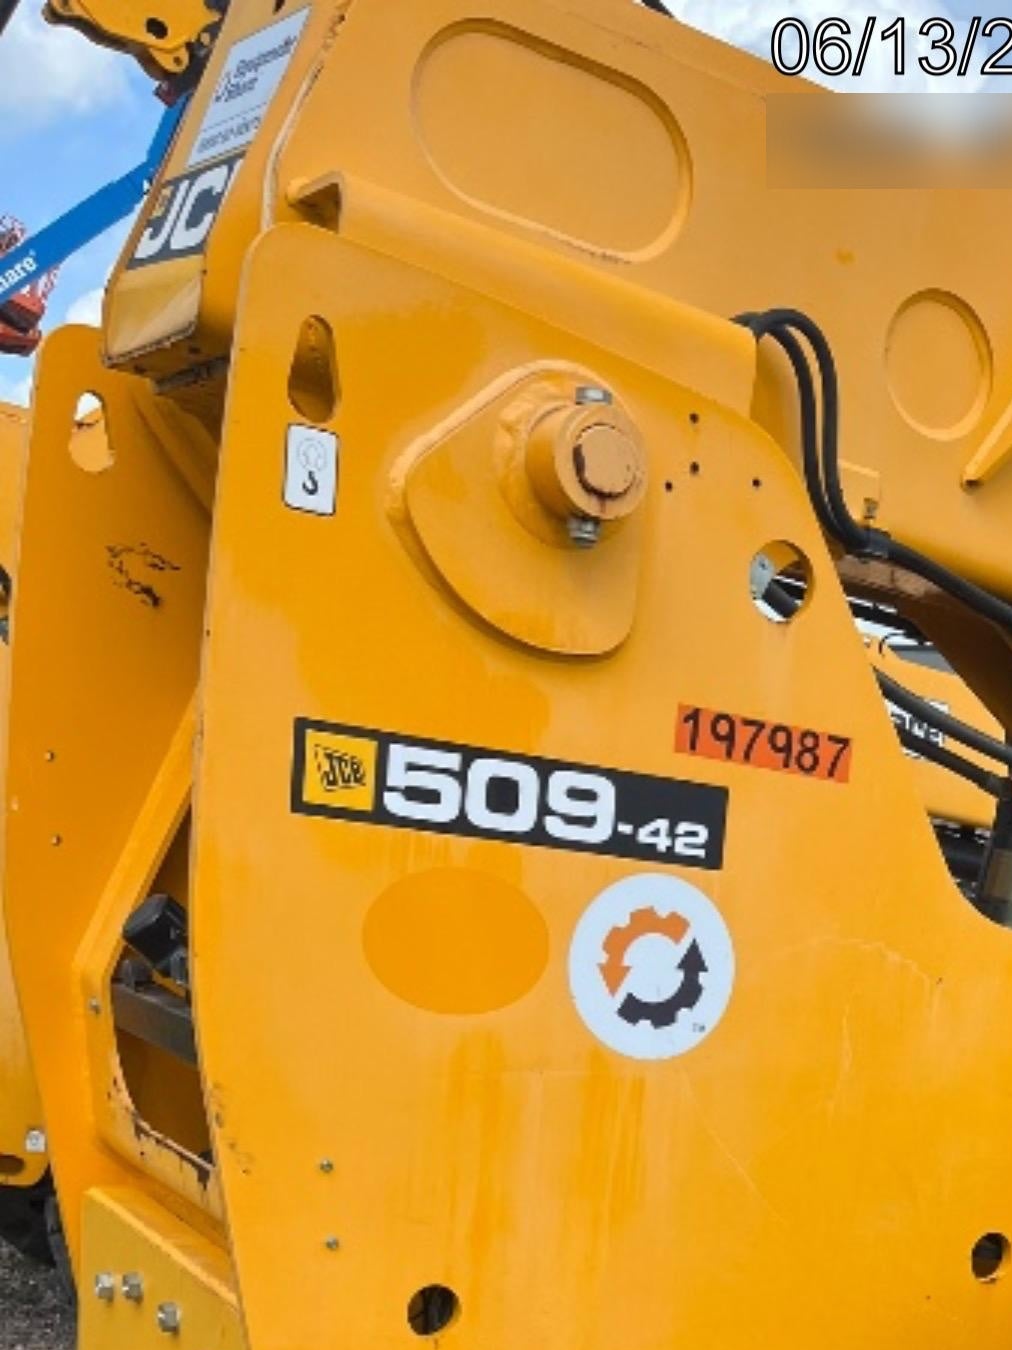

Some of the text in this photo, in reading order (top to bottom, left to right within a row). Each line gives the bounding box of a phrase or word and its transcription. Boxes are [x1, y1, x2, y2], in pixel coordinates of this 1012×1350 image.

[134, 158, 244, 258] JC
[321, 748, 366, 791] JCB
[683, 707, 851, 778] 197987
[382, 742, 710, 859] 509-42
